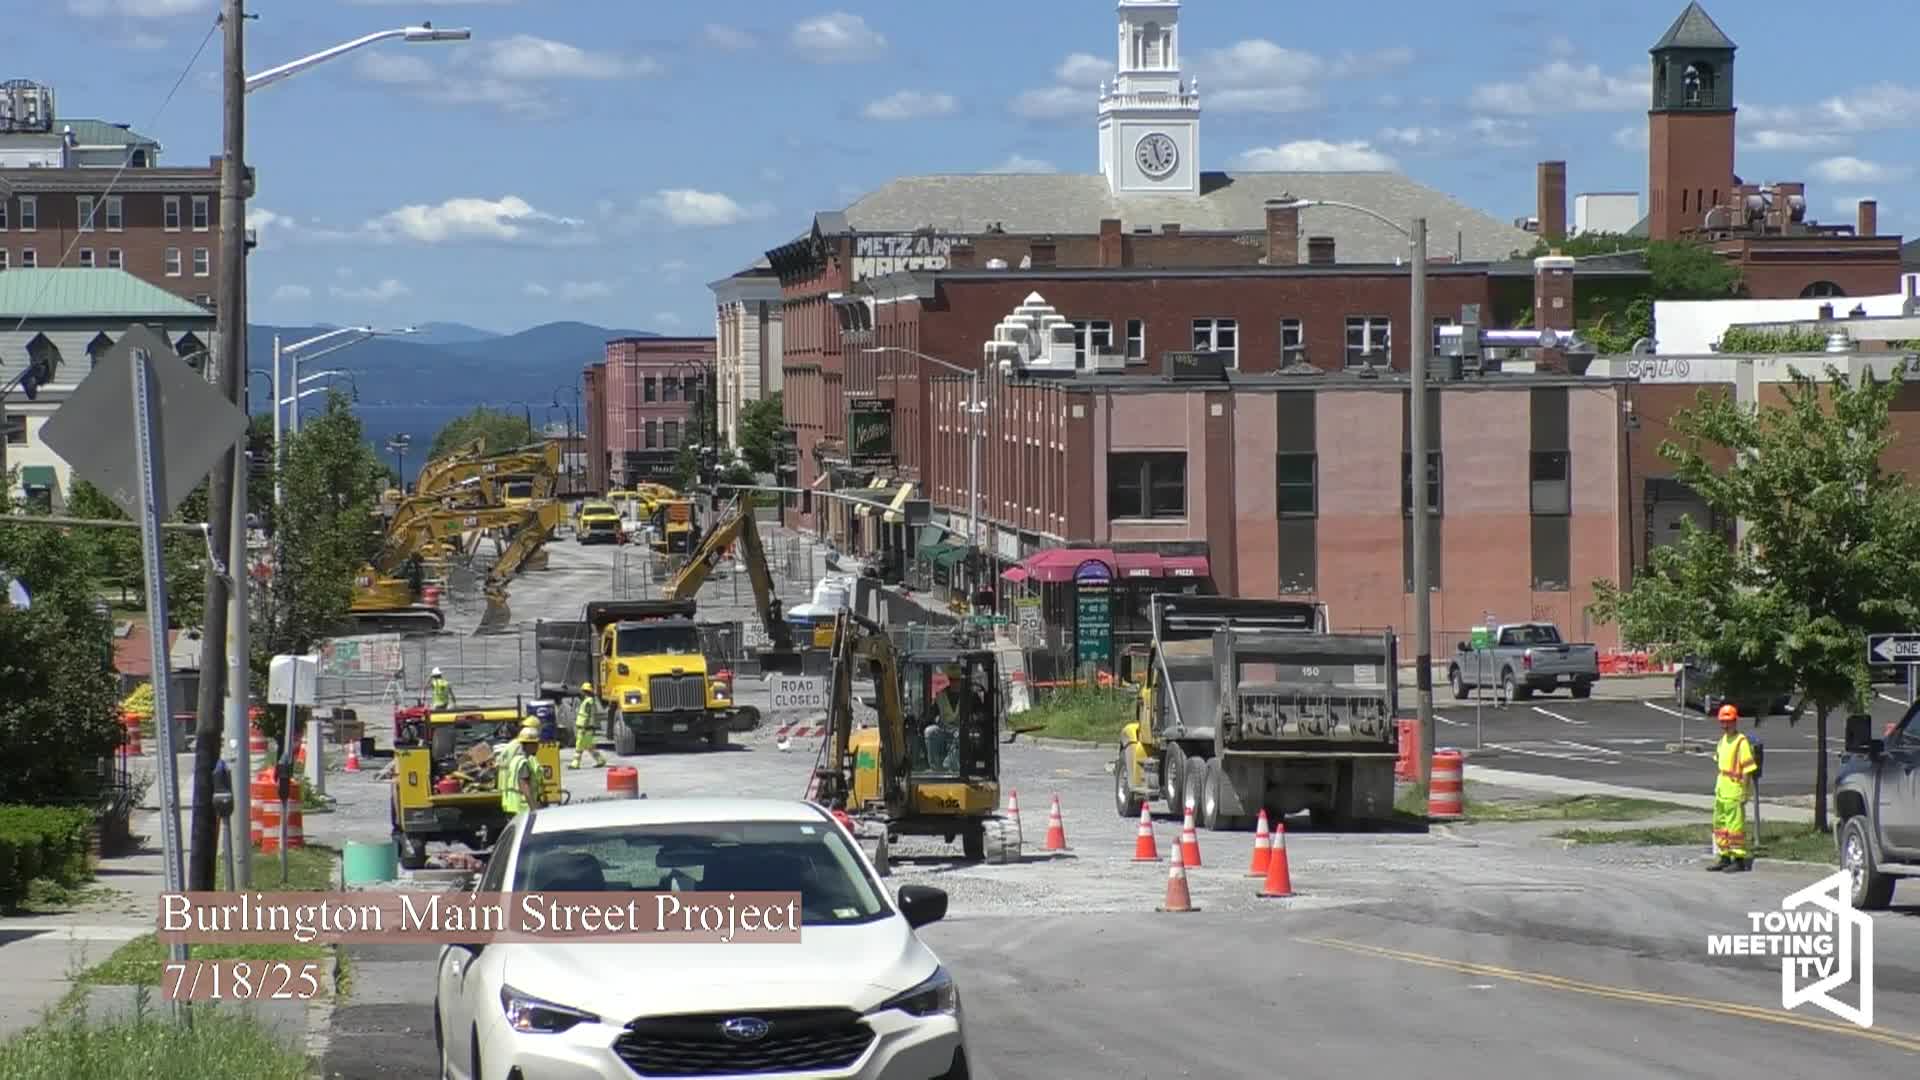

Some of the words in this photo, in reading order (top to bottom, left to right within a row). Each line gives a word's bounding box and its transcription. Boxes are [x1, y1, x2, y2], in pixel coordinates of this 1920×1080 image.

[482, 463, 497, 473] CAT
[464, 517, 478, 526] CAT
[1174, 568, 1194, 577] PIZZA
[1895, 641, 1919, 655] ONE
[1302, 666, 1320, 677] 150
[781, 681, 813, 692] ROAD
[775, 695, 820, 706] CLOSED
